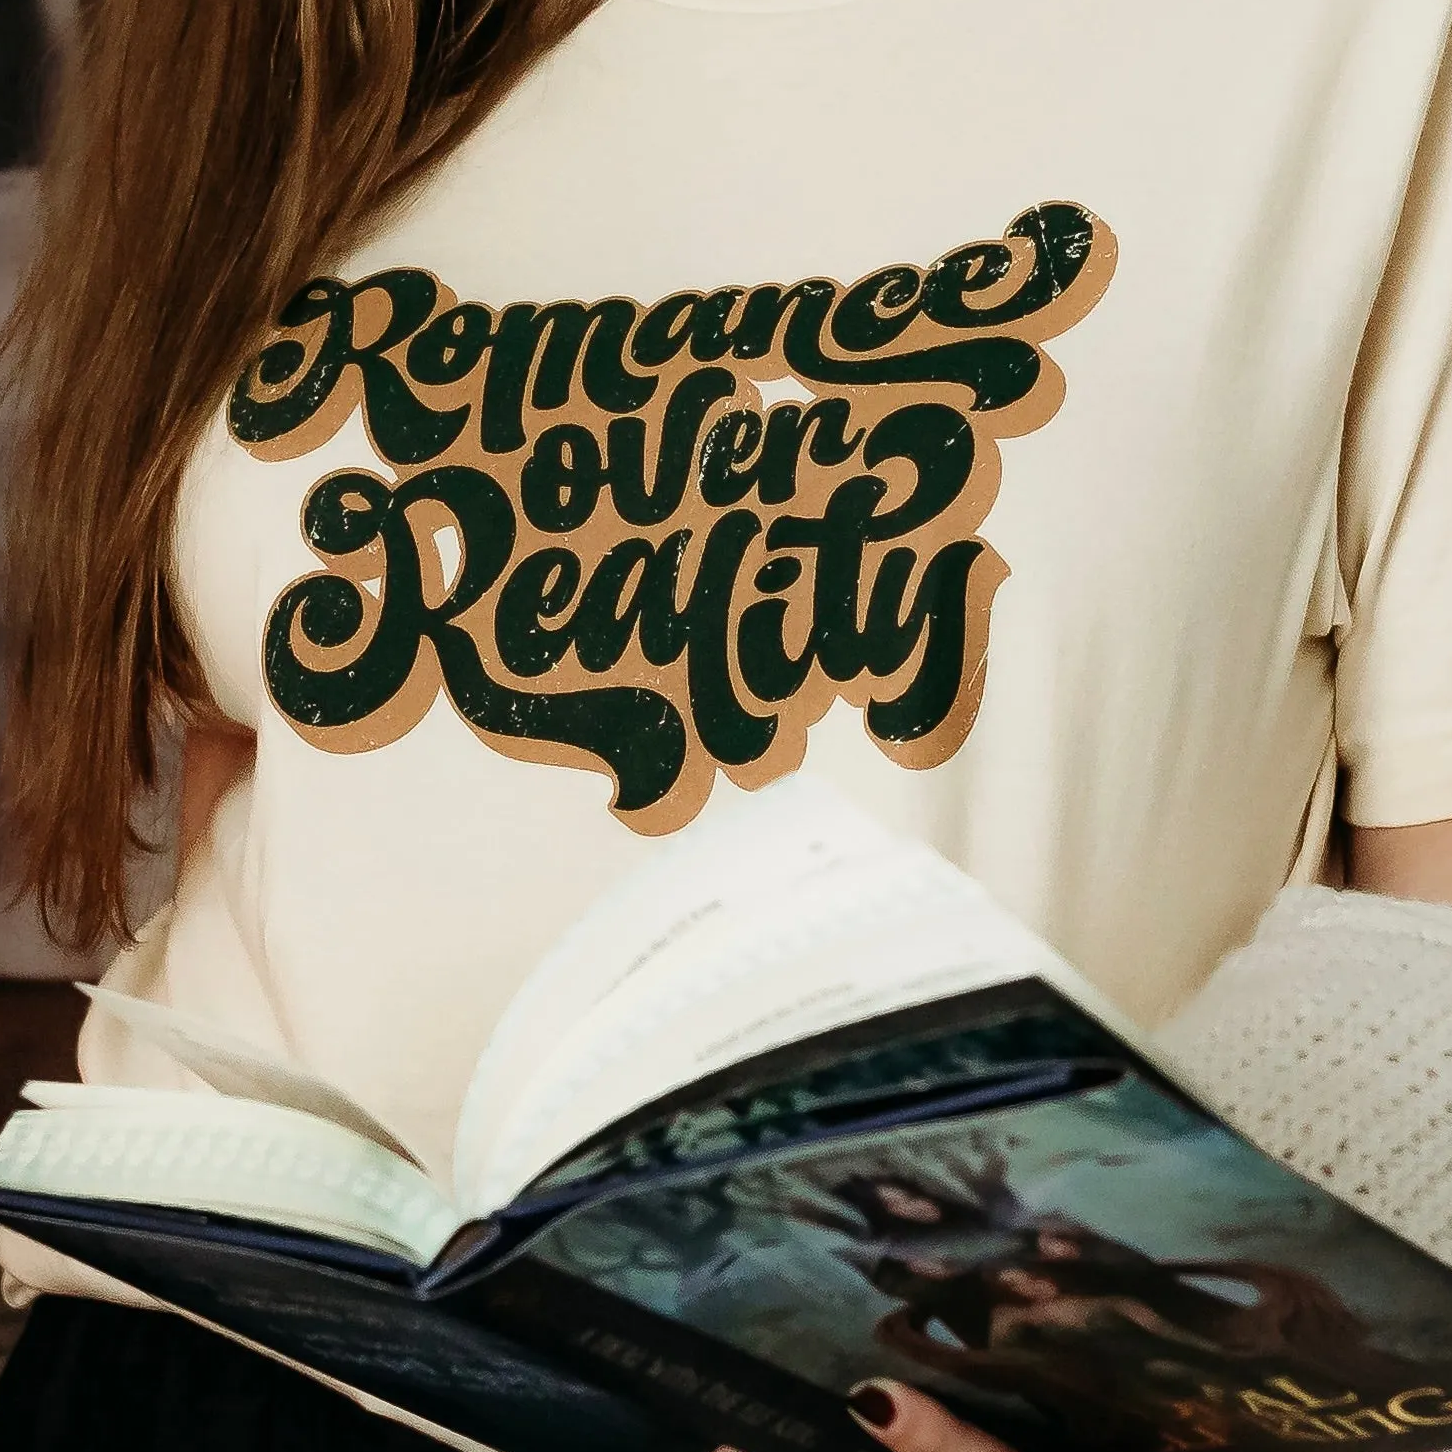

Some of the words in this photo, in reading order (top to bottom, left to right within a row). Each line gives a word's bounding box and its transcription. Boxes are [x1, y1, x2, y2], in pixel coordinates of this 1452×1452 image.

[227, 200, 1117, 467] Romance
[521, 366, 869, 535] over
[262, 403, 1005, 833] Reality
